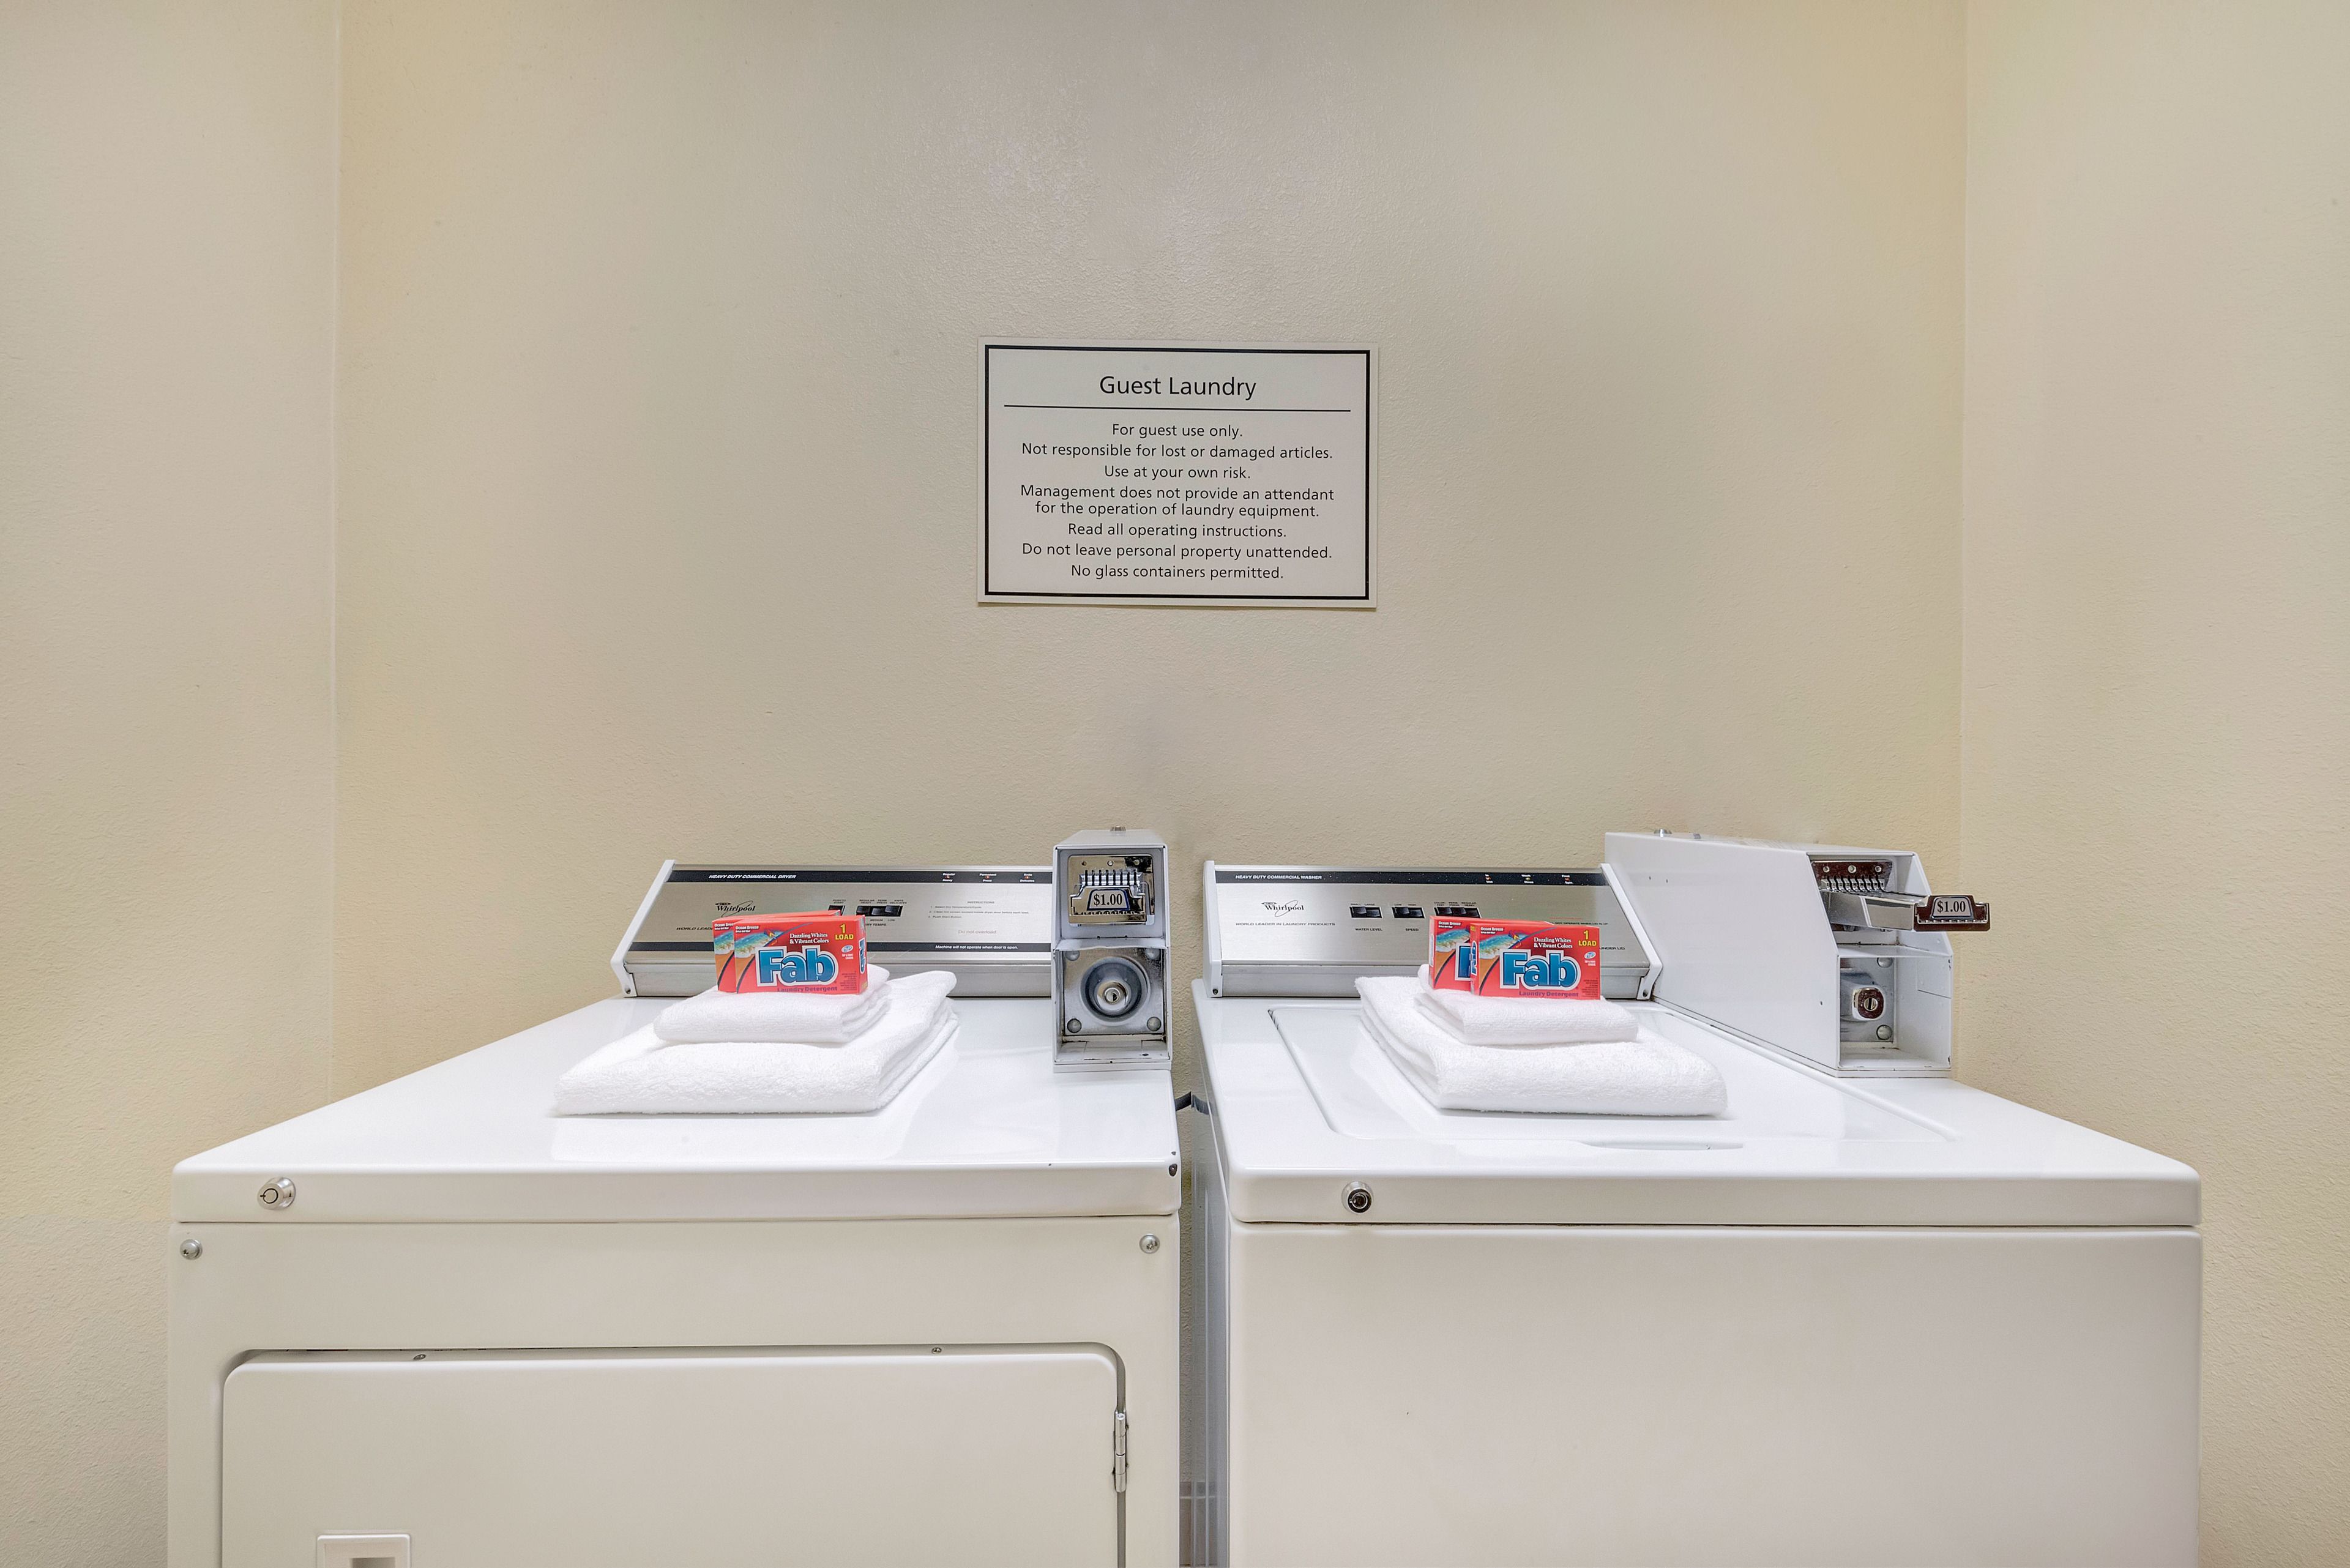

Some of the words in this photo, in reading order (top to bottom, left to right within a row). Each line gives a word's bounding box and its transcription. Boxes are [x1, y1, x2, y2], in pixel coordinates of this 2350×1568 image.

[1100, 376, 1162, 395] Guest
[1169, 376, 1257, 401] Laundry
[1113, 424, 1135, 436] For
[1139, 425, 1177, 439] guest
[1182, 427, 1205, 436] use
[1209, 424, 1243, 440] only.
[1022, 442, 1048, 455] Not
[1053, 443, 1132, 458] responsible
[1135, 444, 1157, 457] for
[1162, 444, 1186, 457] lost
[1190, 448, 1206, 457] or
[1209, 445, 1275, 461] damaged
[1280, 446, 1332, 459] articles.
[1105, 465, 1129, 477] Use
[1133, 466, 1147, 477] at
[1151, 468, 1184, 481] your
[1188, 469, 1218, 478] own
[1223, 466, 1251, 479] risk.
[1021, 484, 1115, 500] Management
[1119, 485, 1152, 498] does
[1157, 488, 1181, 499] not
[1185, 487, 1238, 502] provide
[1242, 490, 1259, 499] an
[1264, 488, 1335, 501] attendant
[1035, 501, 1056, 513] for
[1060, 501, 1084, 514] the
[1088, 502, 1157, 517] operation
[1162, 502, 1177, 515] of
[1182, 502, 1234, 519] laundry
[1239, 504, 1319, 520] equipment.
[1069, 523, 1102, 535] Read
[1108, 523, 1123, 536] all
[1128, 524, 1197, 539] operating
[1203, 524, 1286, 537] instructions.
[1023, 543, 1042, 555] Do
[1047, 544, 1071, 555] not
[1076, 543, 1112, 556] leave
[1116, 544, 1176, 559] personal
[1181, 547, 1242, 561] property
[1246, 545, 1332, 559] unattended.
[1072, 564, 1091, 577] No
[1095, 564, 1128, 580] glass
[1133, 565, 1206, 578] containers
[1210, 566, 1283, 581] permitted.
[1094, 894, 1122, 906] $1.00
[1938, 900, 1966, 913] $1.00
[840, 924, 846, 933] 1
[1583, 930, 1589, 940] 1
[756, 946, 838, 985] Fab
[1501, 950, 1580, 989] Fab
